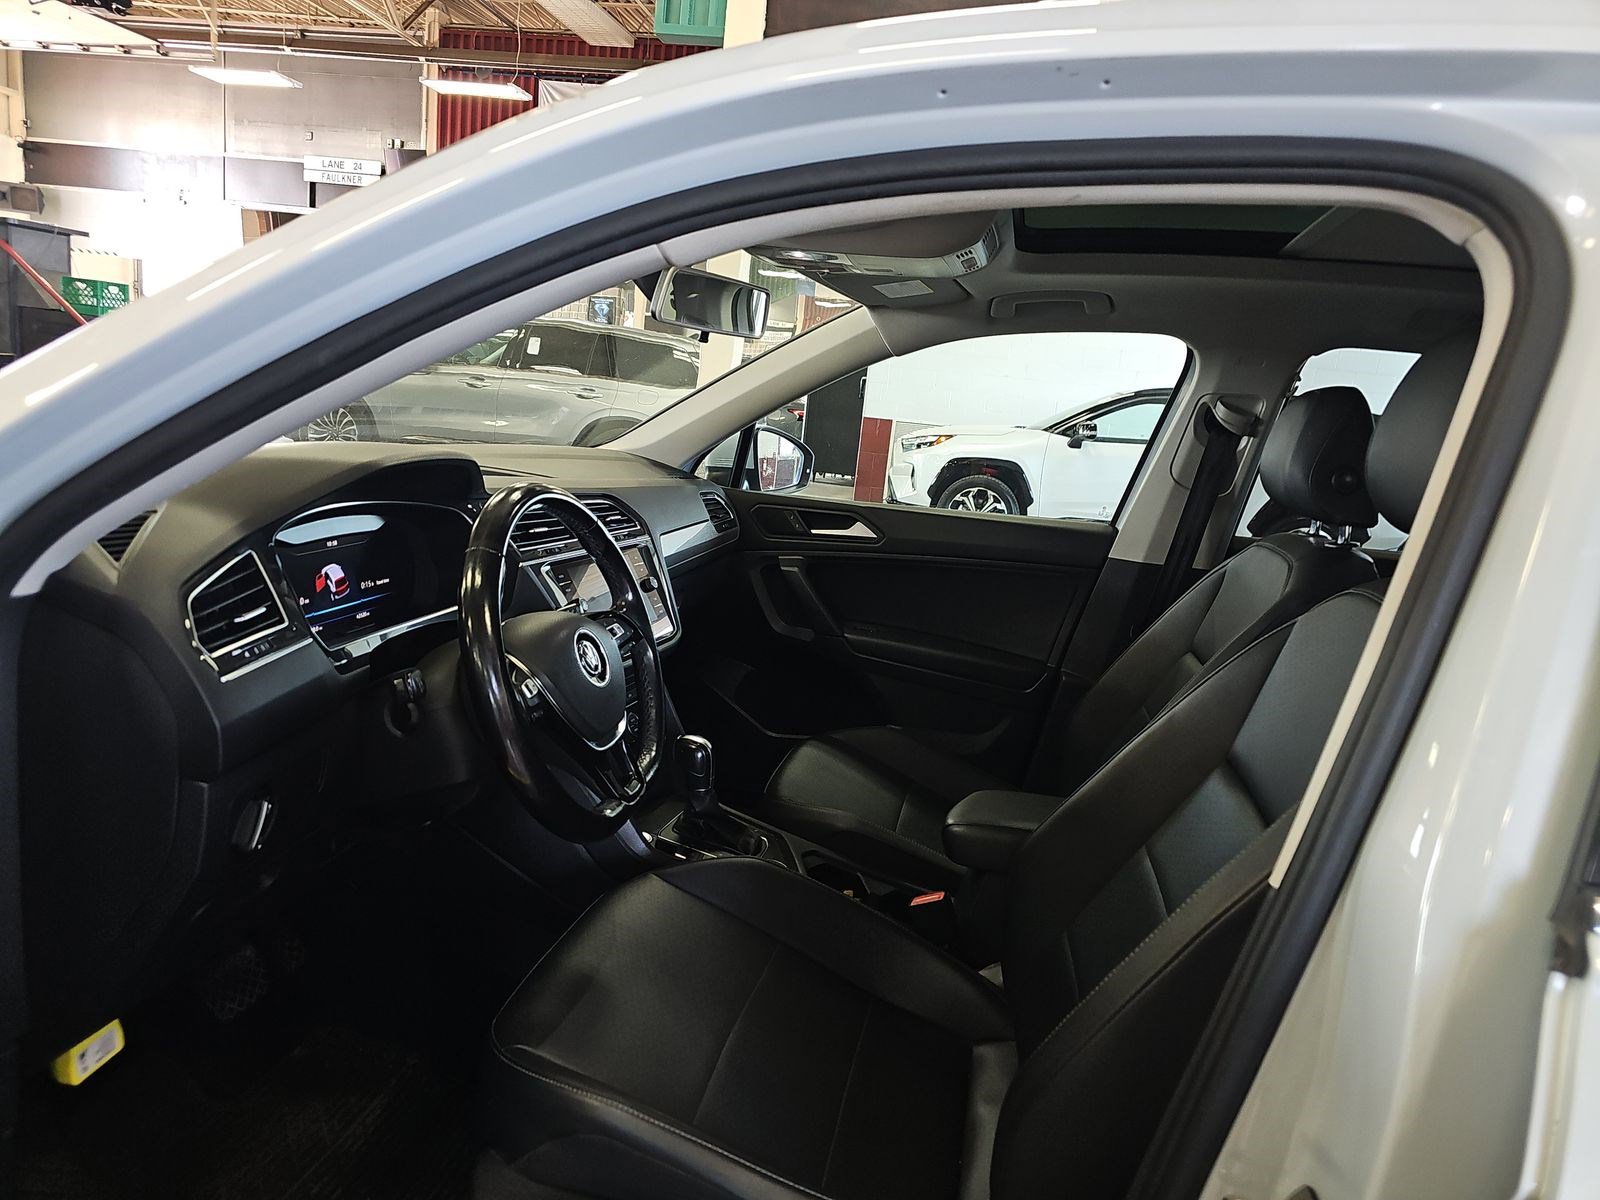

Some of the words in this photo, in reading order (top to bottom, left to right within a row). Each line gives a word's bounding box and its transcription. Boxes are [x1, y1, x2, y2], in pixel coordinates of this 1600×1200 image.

[321, 159, 345, 169] LANE
[353, 162, 362, 171] 24
[321, 172, 363, 184] FAULKNER
